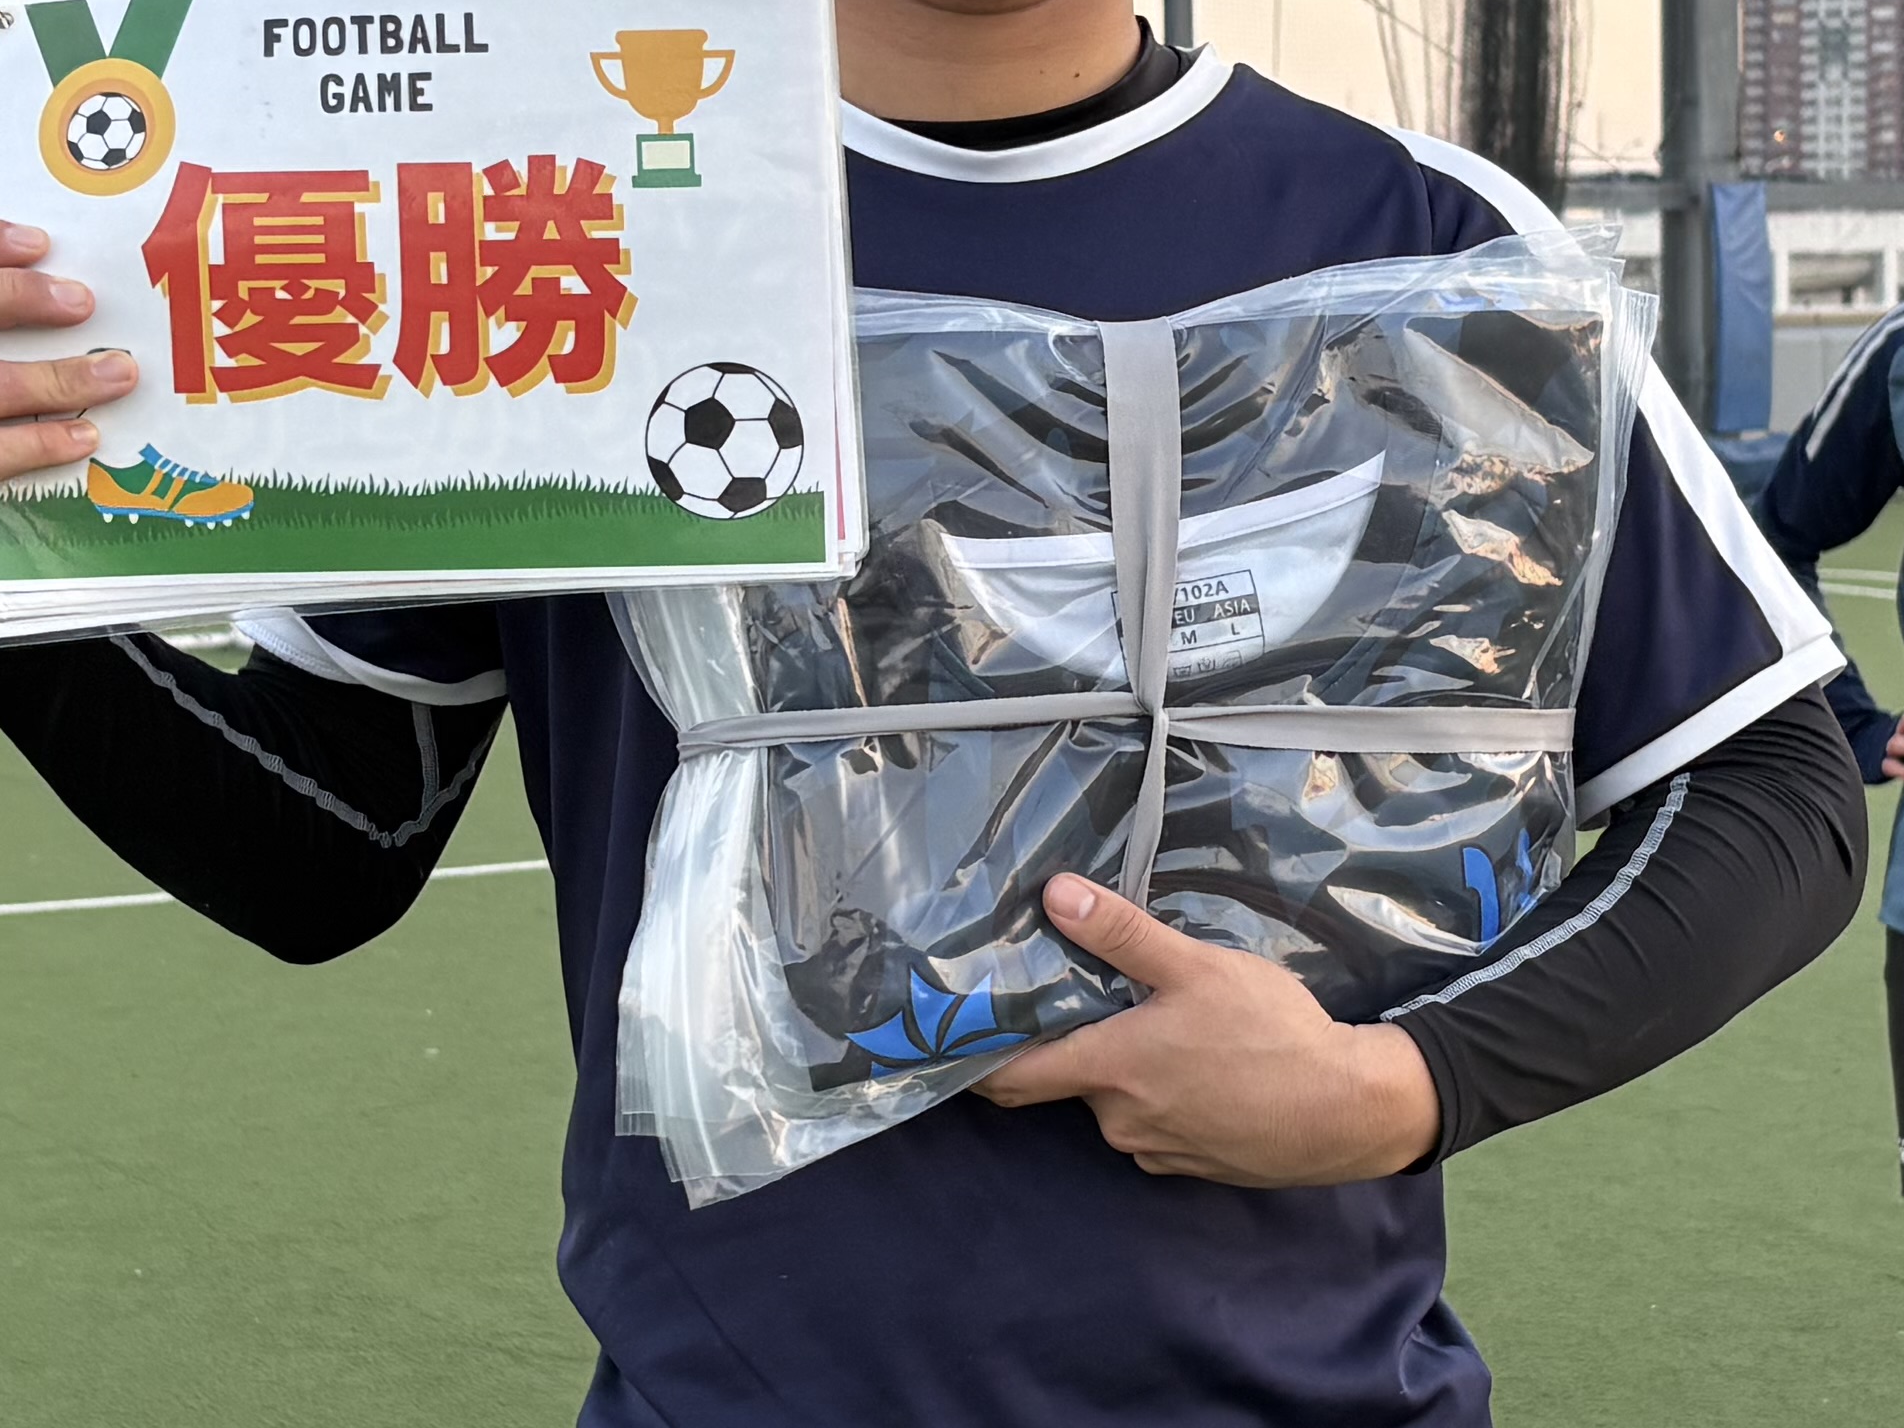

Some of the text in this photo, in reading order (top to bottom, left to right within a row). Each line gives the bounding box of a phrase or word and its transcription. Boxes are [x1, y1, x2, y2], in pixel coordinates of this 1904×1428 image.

[263, 12, 489, 58] FOOTBALL
[320, 72, 433, 114] GAME
[141, 154, 638, 404] 優勝
[1174, 598, 1251, 625] EU ASIA
[1181, 623, 1241, 645] M L
